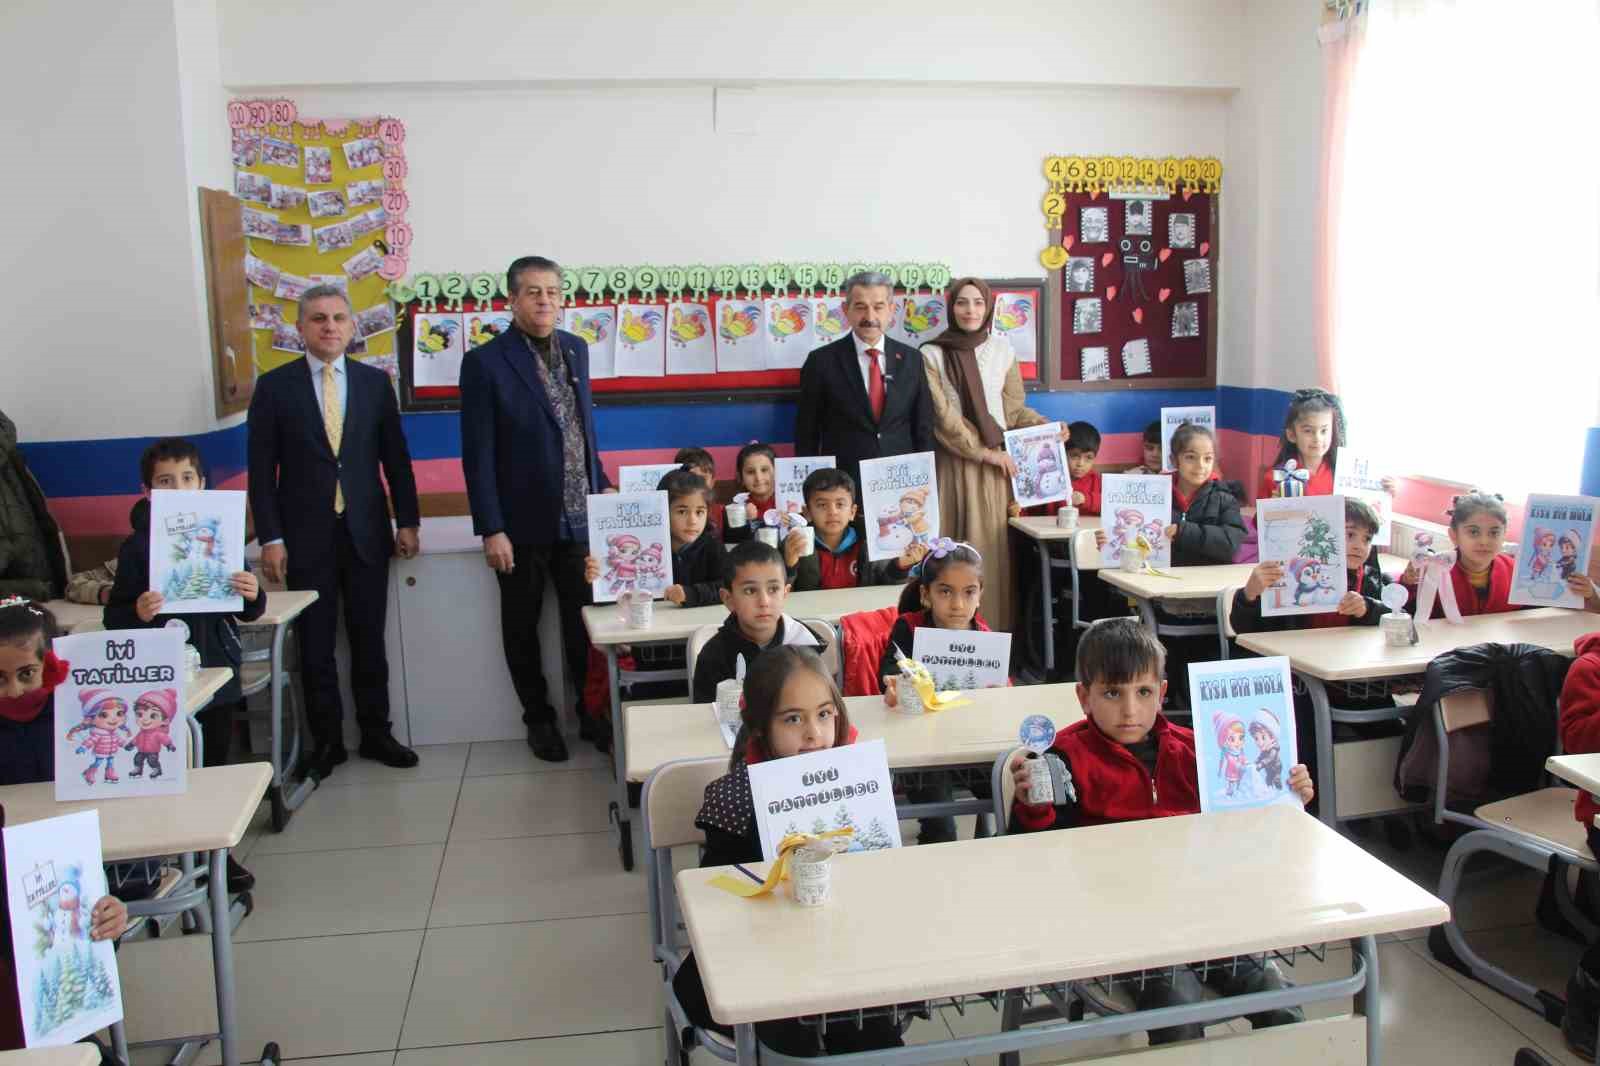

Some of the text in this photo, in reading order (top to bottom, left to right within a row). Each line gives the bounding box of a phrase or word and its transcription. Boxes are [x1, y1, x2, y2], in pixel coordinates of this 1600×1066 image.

[274, 103, 289, 122] 80
[385, 123, 400, 142] 40
[387, 160, 402, 179] 30
[1050, 160, 1216, 180] 4 6 8 10 12 14 16 18 20
[387, 192, 402, 211] 20
[1047, 198, 1061, 216] 2
[390, 227, 405, 245] 10
[419, 280, 433, 298] 1
[447, 277, 461, 295] 2
[478, 279, 491, 296] 3
[587, 271, 601, 289] 7
[613, 271, 627, 289] 8
[640, 271, 654, 289] 9
[666, 270, 681, 289] 10
[692, 271, 706, 289] 11
[720, 269, 735, 287] 12
[745, 269, 761, 287] 13
[772, 267, 787, 285] 14
[798, 267, 814, 285] 15
[823, 267, 839, 285] 16
[905, 268, 920, 286] 19
[929, 268, 945, 286] 20
[71, 662, 175, 686] TATİLLER
